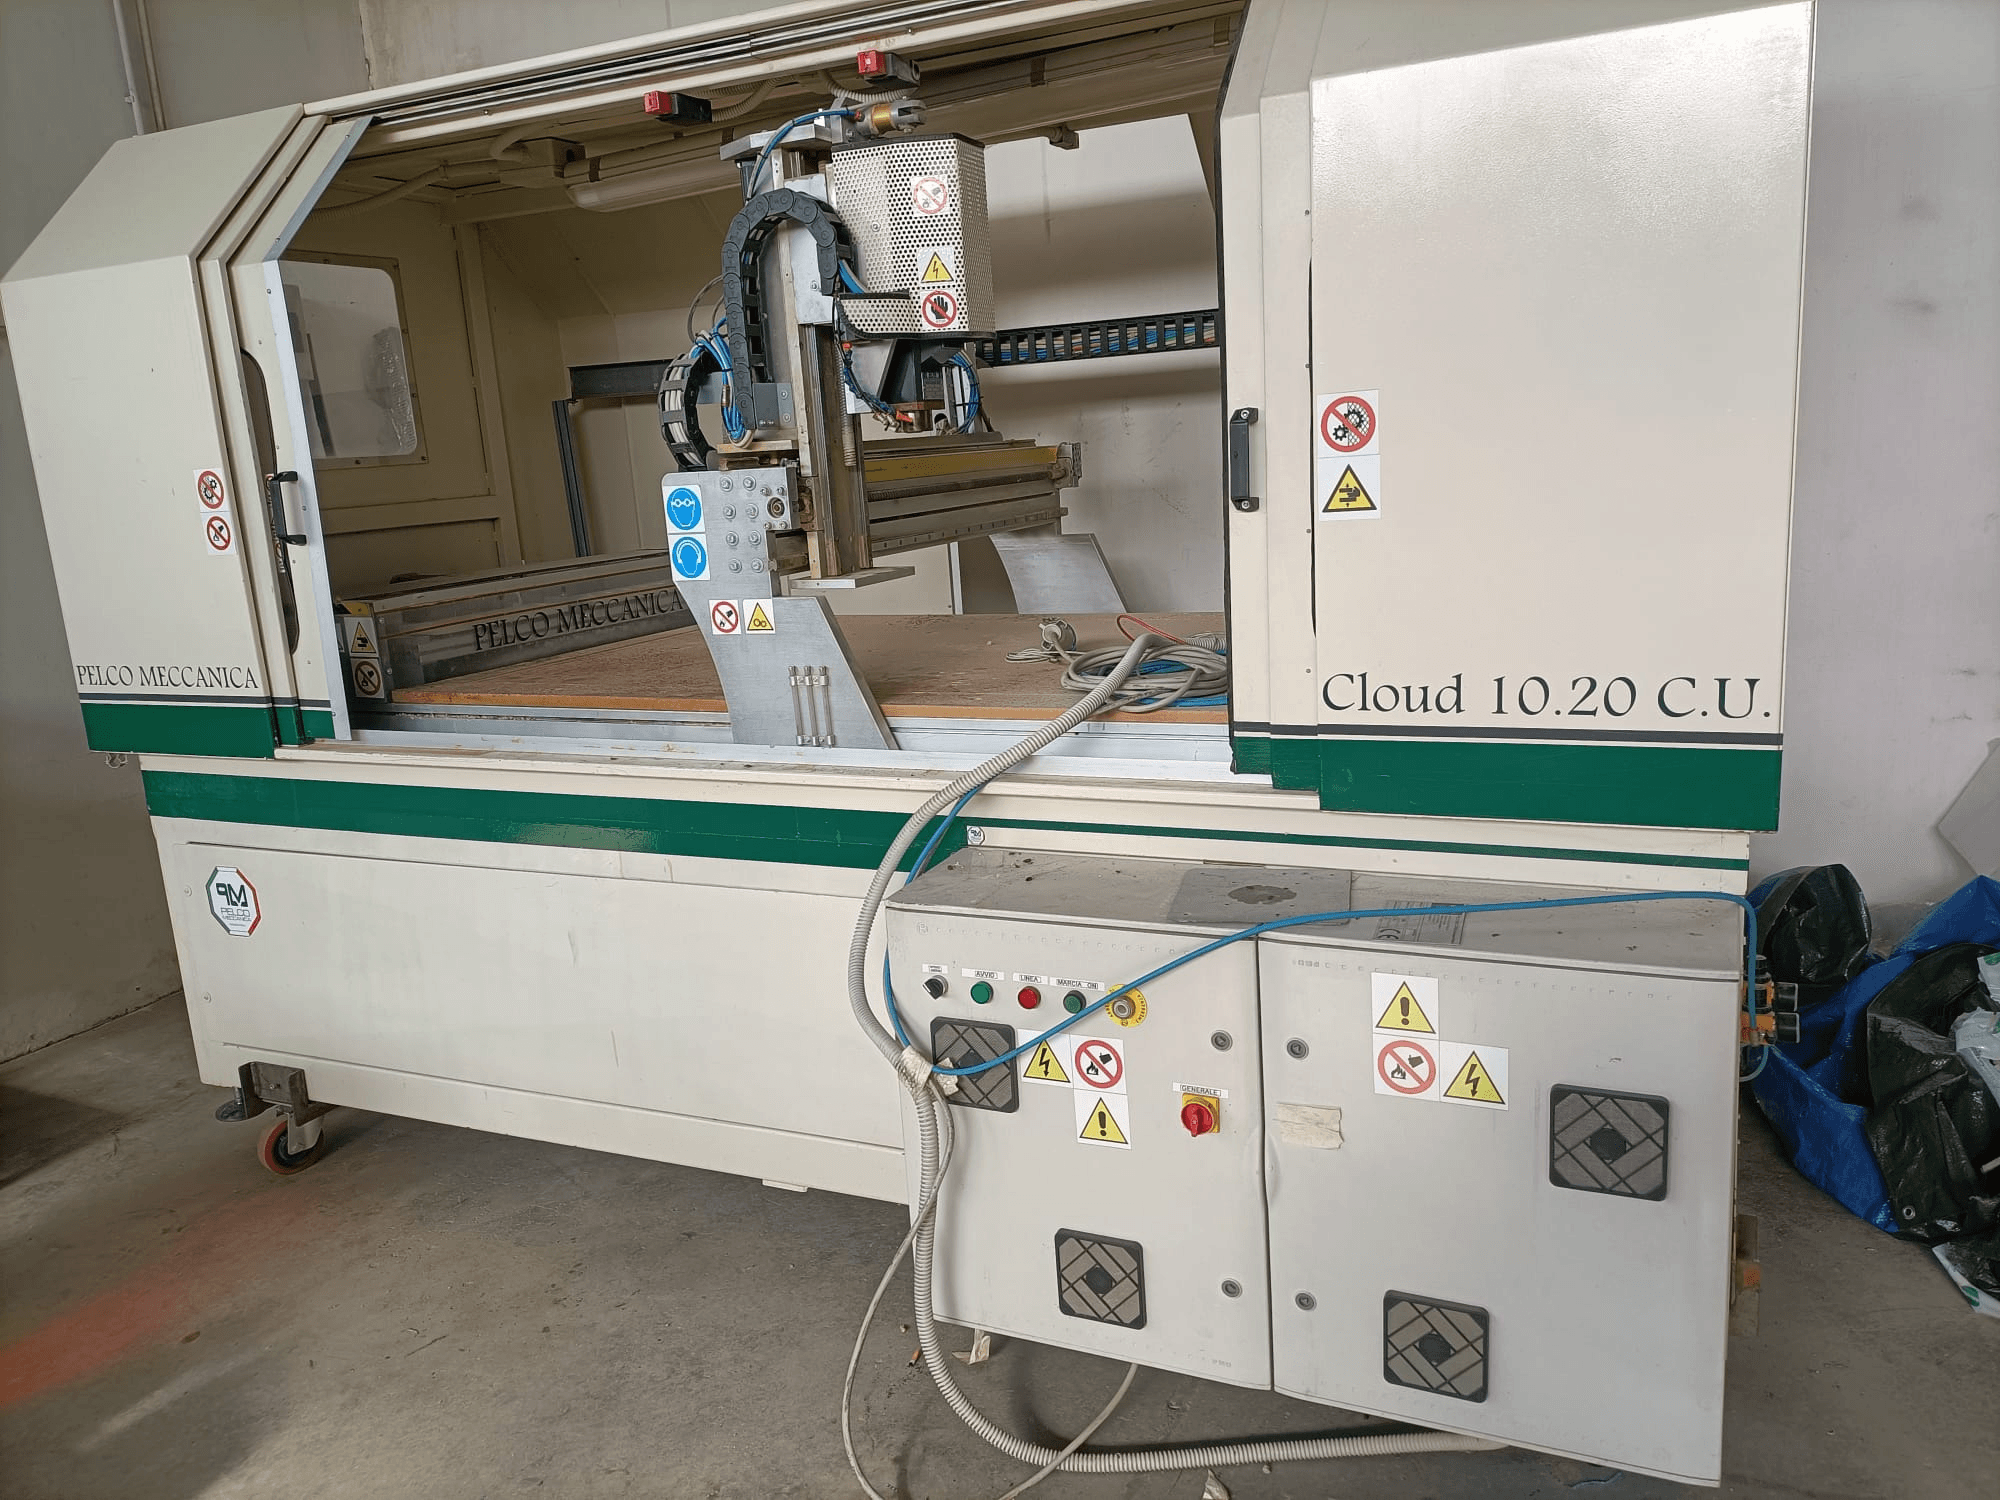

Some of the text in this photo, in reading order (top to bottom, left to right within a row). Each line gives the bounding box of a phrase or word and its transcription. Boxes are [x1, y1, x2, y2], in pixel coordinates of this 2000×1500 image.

[472, 589, 684, 650] PELCO MECCANICA
[76, 665, 259, 689] PELCO MECCANICA
[1322, 672, 1771, 719] Cloud 10.20 C.U.
[1020, 974, 1039, 982] LINEA
[1056, 978, 1082, 988] MARCIA
[1180, 1084, 1219, 1096] GENERALE
